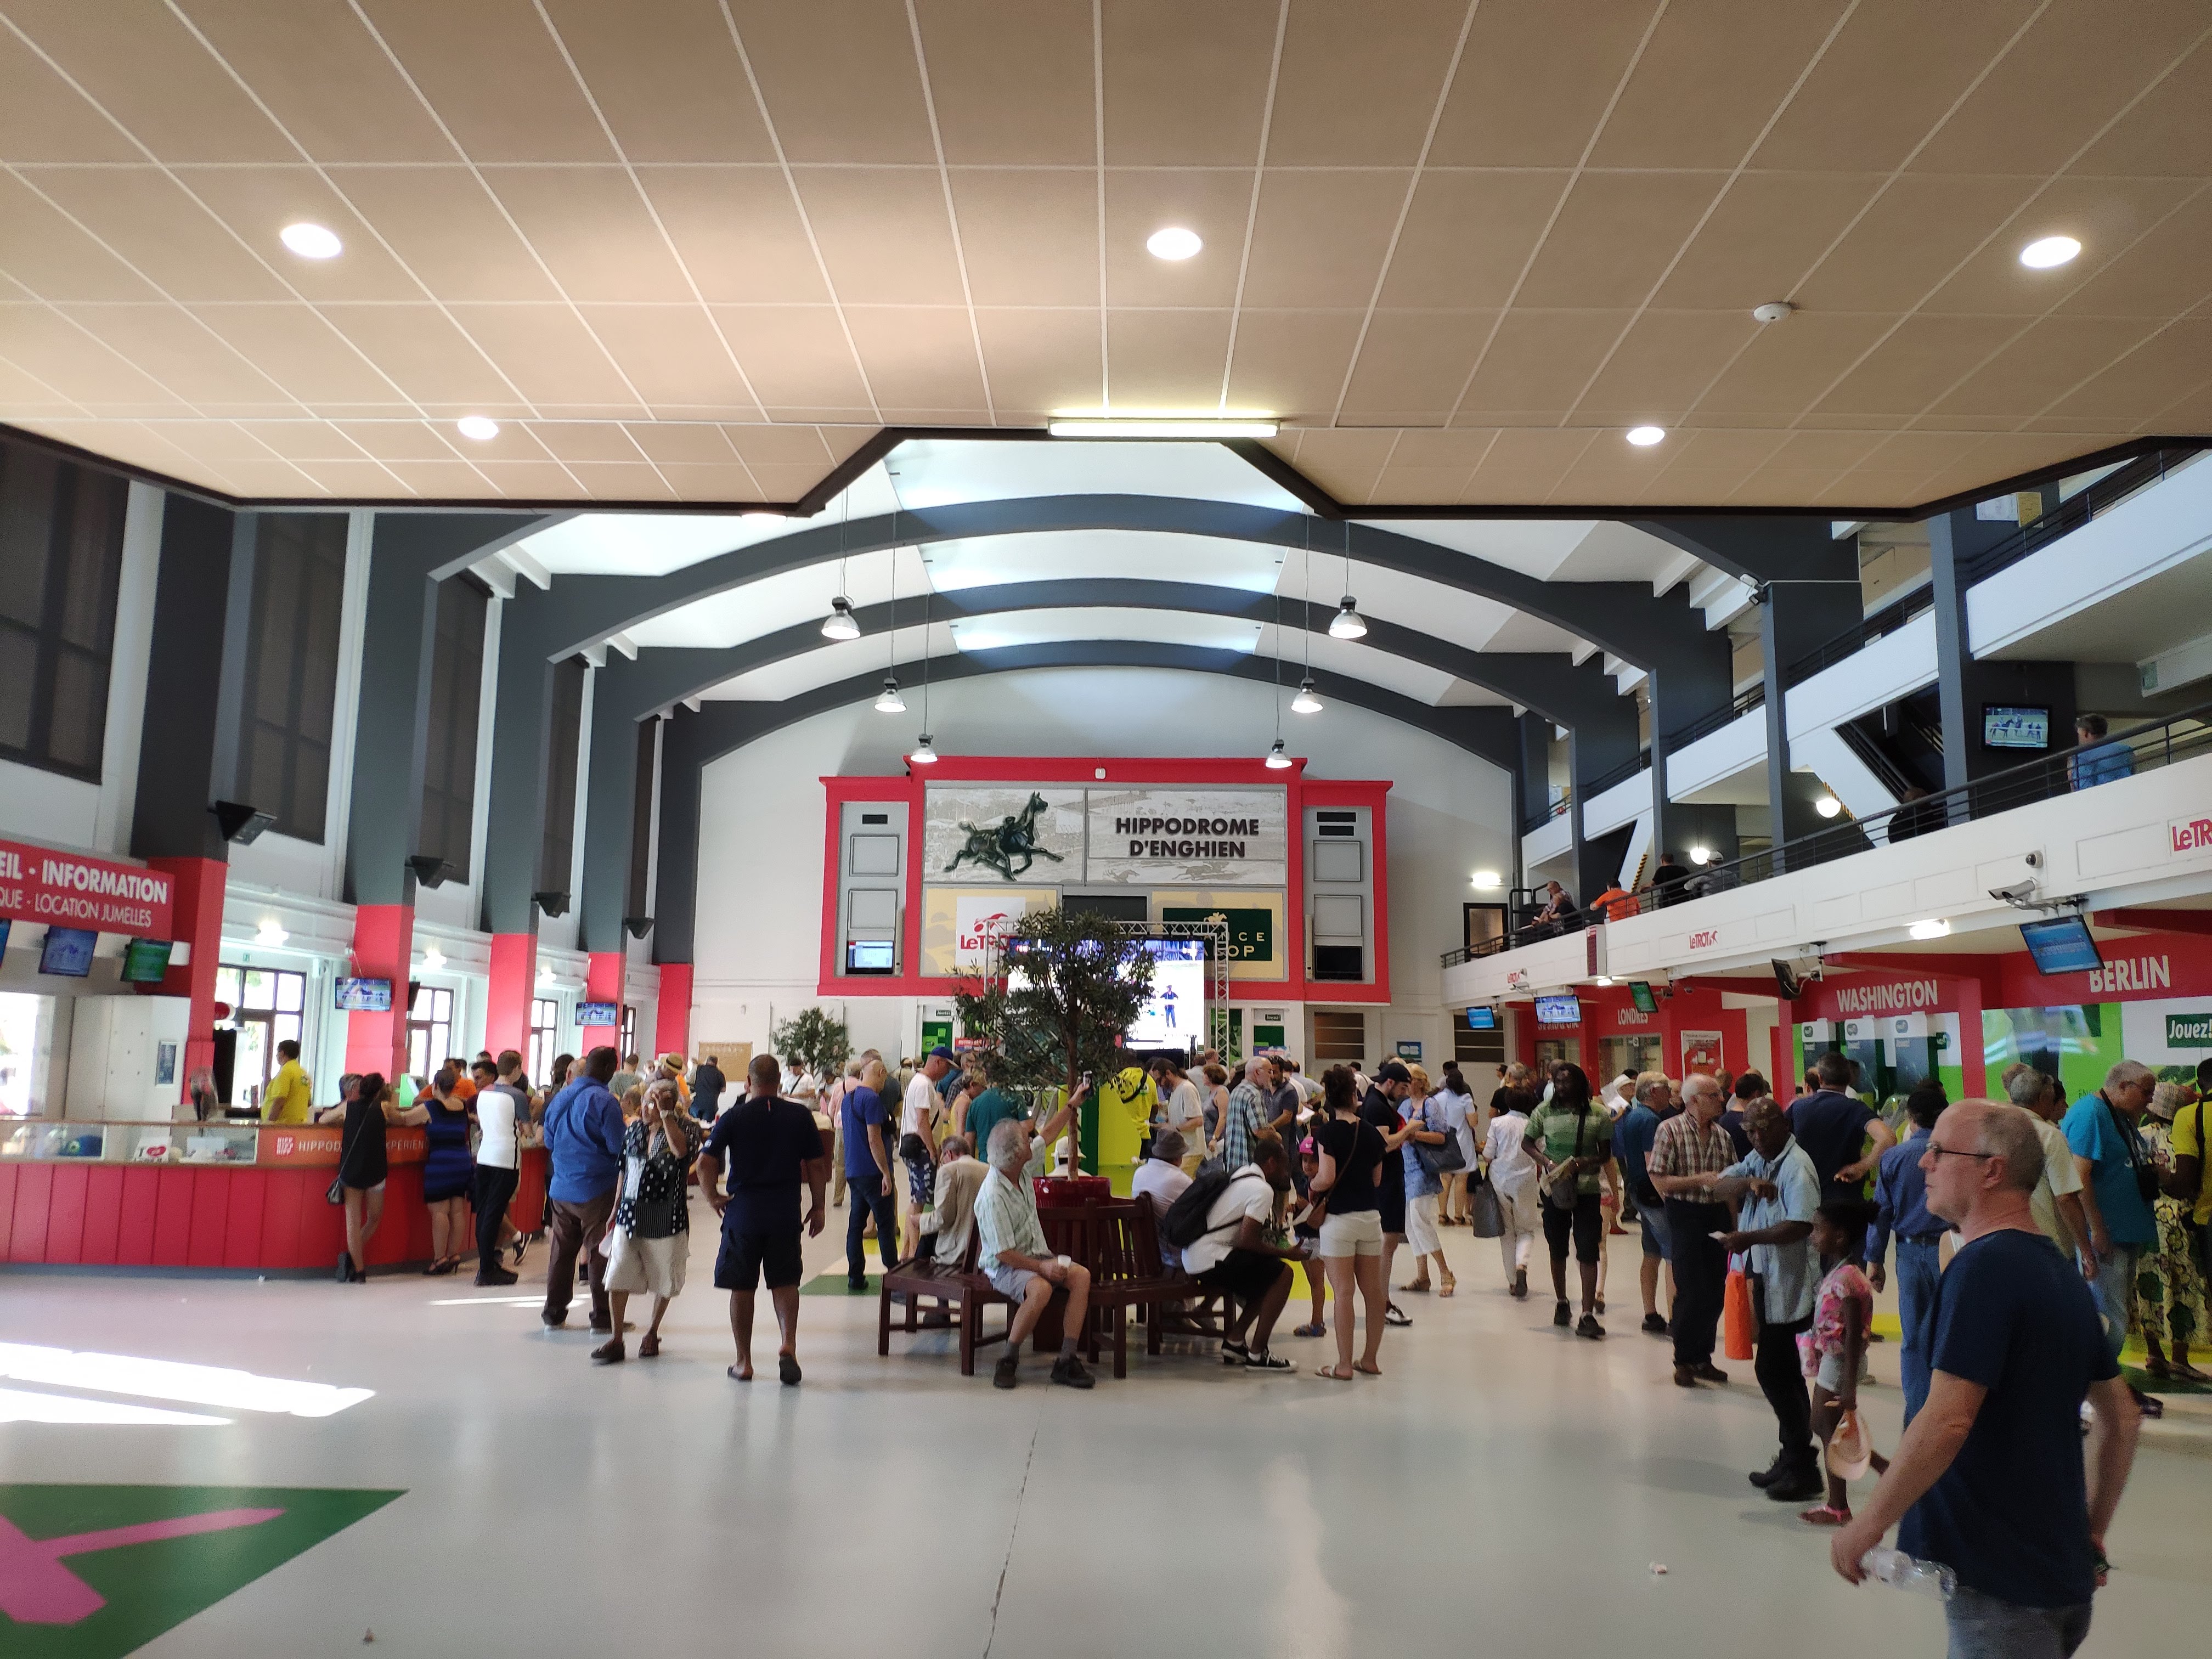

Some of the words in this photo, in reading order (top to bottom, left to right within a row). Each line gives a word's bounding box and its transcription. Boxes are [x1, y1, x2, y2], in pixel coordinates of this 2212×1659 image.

[1116, 817, 1260, 836] HIPPODROME
[2172, 819, 2212, 851] LeTR
[1130, 840, 1246, 857] D'ENGHIEN
[42, 859, 167, 904] INFORMATION
[35, 893, 99, 919] LOCATION
[101, 903, 152, 928] JUMELLES
[1689, 931, 1710, 950] LeTROT
[2089, 955, 2171, 993] BERLIN
[1836, 979, 1938, 1013] WASHINGTON
[1617, 1007, 1649, 1025] LONDRES
[2169, 1019, 2212, 1039] Jouez!
[298, 1141, 342, 1153] HIPPOD
[386, 1139, 429, 1150] PERIEN
